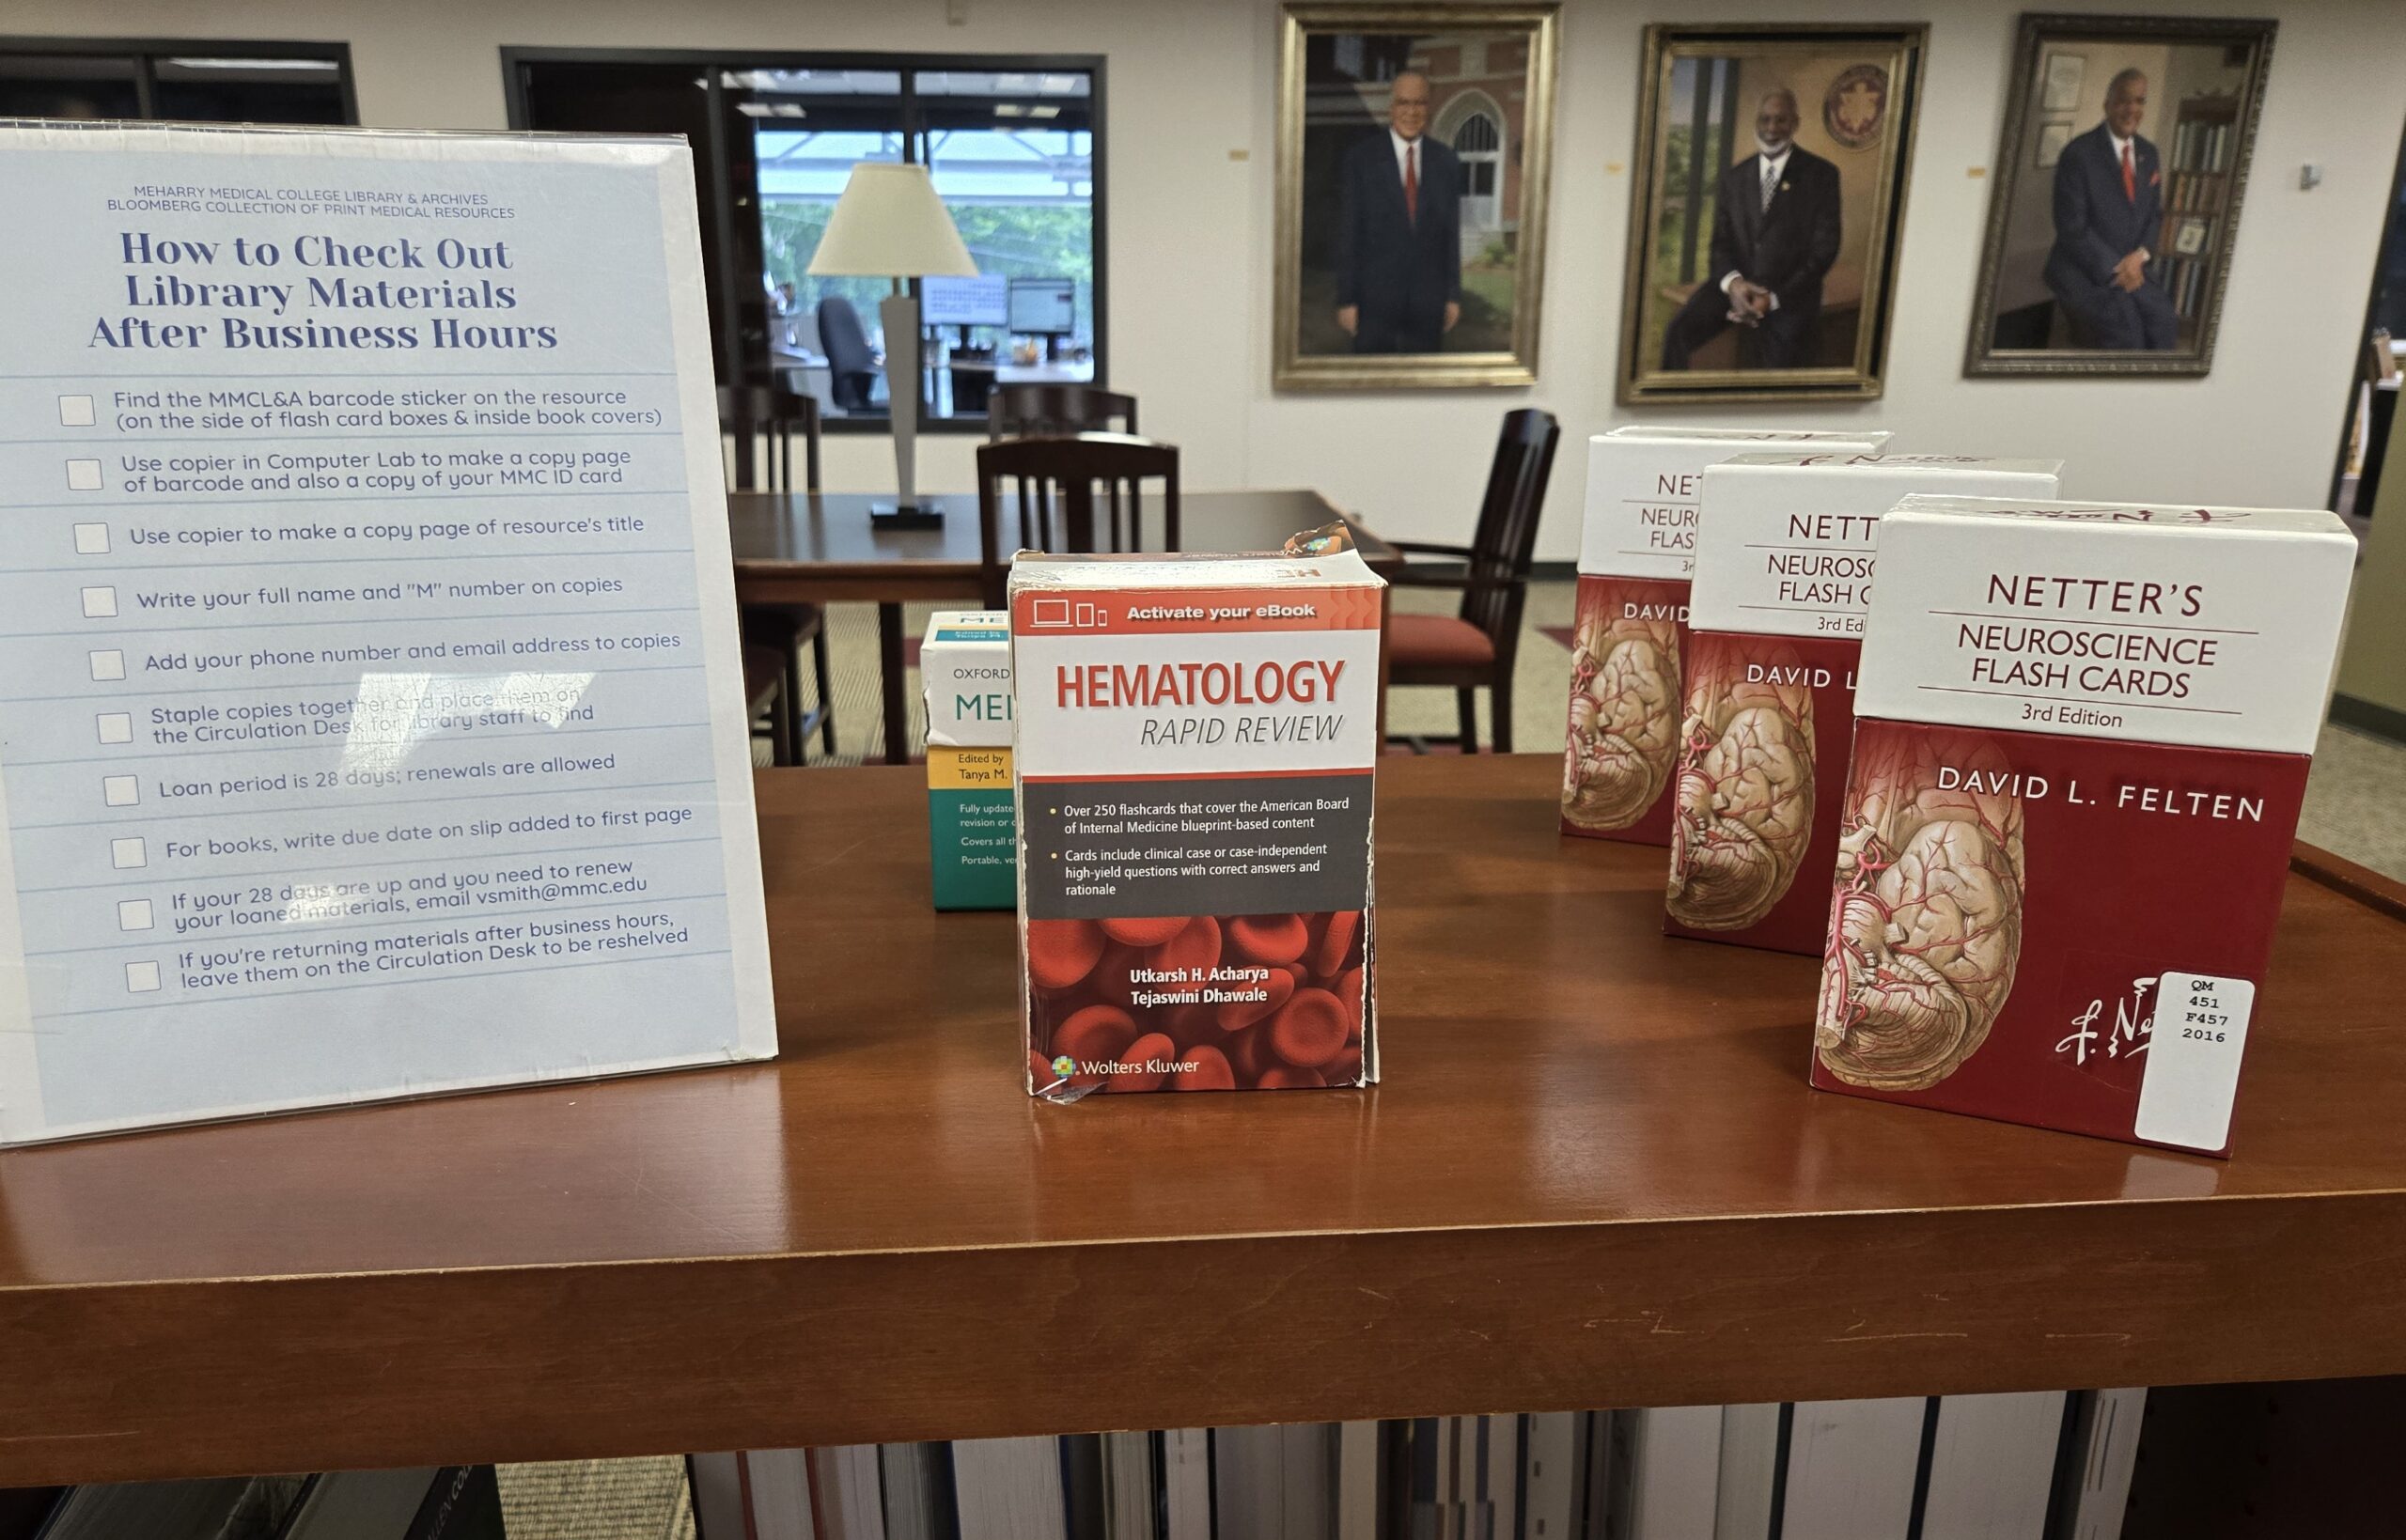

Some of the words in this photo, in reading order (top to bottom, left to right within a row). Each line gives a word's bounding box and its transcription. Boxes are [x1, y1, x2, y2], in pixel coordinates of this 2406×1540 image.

[133, 184, 205, 198] MEHARRY
[209, 186, 273, 200] MEDICAL
[275, 187, 340, 202] COLLEGE
[343, 189, 402, 204] LIBRARY
[407, 191, 417, 204] &
[420, 192, 488, 206] ARCHIVES
[106, 197, 201, 212] BLOOMBERG
[205, 200, 296, 215] COLLECTION
[300, 202, 319, 215] OF
[323, 203, 365, 216] PRINT
[370, 204, 430, 218] MEDICAL
[433, 205, 515, 220] RESOURCES
[122, 231, 220, 266] How
[232, 234, 279, 267] to
[293, 233, 424, 269] Check
[436, 234, 513, 270] Out
[127, 273, 293, 317] Library
[308, 274, 516, 309] Materials
[87, 314, 208, 349] After
[224, 315, 418, 350] Business
[433, 315, 557, 350] Hours
[114, 389, 160, 409] Find
[165, 389, 202, 408] the
[208, 388, 303, 408] MMCL&A
[308, 387, 395, 407] barcode
[400, 387, 467, 406] sticker
[473, 391, 498, 406] on
[503, 386, 536, 406] the
[541, 391, 626, 405] resource
[116, 410, 152, 433] (on
[158, 410, 195, 429] the
[201, 410, 243, 429] side
[250, 409, 273, 428] of
[277, 409, 329, 428] flash
[336, 408, 383, 428] card
[388, 408, 448, 428] boxes
[453, 407, 469, 427] &
[474, 406, 530, 426] inside
[536, 405, 586, 426] book
[590, 403, 662, 428] covers)
[1641, 507, 1698, 526] NEUR
[136, 588, 195, 609] Write
[202, 591, 252, 612] your
[257, 584, 289, 605] full
[296, 587, 355, 603] name
[362, 581, 400, 601] and
[448, 577, 525, 599] number
[531, 581, 555, 595] on
[561, 574, 623, 599] copies
[1779, 581, 1852, 605] FLASH
[1987, 574, 2203, 617] NETTER'S
[1126, 604, 1204, 620] Activate
[1208, 606, 1251, 622] your
[1255, 601, 1315, 617] eBook
[1624, 602, 1690, 623] DAVID
[1817, 616, 1841, 631] 3rd
[1958, 623, 2218, 666] NEUROSCIENCE
[953, 668, 1011, 679] OXFORD
[1056, 660, 1346, 708] HEMATOLOGY
[1746, 663, 1831, 688] DAVID
[1972, 658, 2070, 690] FLASH
[2079, 665, 2191, 699] CARDS
[2021, 703, 2053, 722] 3rd
[2058, 707, 2122, 728] Edition
[1140, 718, 1225, 745] RAPID
[1234, 714, 1343, 743] REVIEW
[958, 754, 990, 763] Edited
[992, 754, 1004, 766] by
[958, 769, 991, 783] Tanya
[993, 769, 1008, 780] M.
[1936, 766, 2050, 800] DAVID
[2068, 780, 2096, 805] L.
[2117, 786, 2265, 823] FELTEN
[960, 803, 981, 815] Fully
[1063, 803, 1091, 817] Over
[1093, 802, 1117, 817] 250
[1118, 801, 1176, 817] flashcards
[1179, 801, 1203, 815] that
[1205, 802, 1237, 815] cover
[1239, 799, 1258, 814] the
[1258, 797, 1312, 813] American
[1316, 795, 1350, 811] Board
[960, 818, 995, 827] revision
[1064, 820, 1076, 835] of
[1079, 819, 1123, 834] Internal
[1126, 818, 1179, 833] Medicine
[1180, 816, 1269, 834] blueprint-based
[1271, 815, 1315, 830] content
[961, 836, 993, 847] Covers
[995, 836, 1007, 847] all
[1064, 847, 1098, 862] Cards
[1100, 846, 1141, 862] include
[1143, 845, 1182, 861] clinical
[1185, 848, 1211, 859] case
[1213, 848, 1226, 859] or
[1228, 842, 1327, 860] case-independent
[1065, 863, 1120, 882] high-yield
[1123, 863, 1178, 881] questions
[1180, 862, 1206, 877] with
[1209, 861, 1248, 876] correct
[1250, 863, 1296, 875] answers
[1298, 858, 1320, 873] and
[1065, 881, 1116, 896] rationale
[179, 950, 194, 970] If
[199, 945, 265, 972] you're
[272, 936, 367, 961] returning
[373, 926, 469, 951] materials
[475, 923, 523, 942] after
[529, 916, 611, 938] business
[616, 910, 674, 930] hours,
[181, 971, 238, 990] leave
[243, 964, 298, 984] them
[305, 962, 331, 978] on
[336, 955, 370, 975] the
[376, 945, 483, 971] Circulation
[489, 938, 537, 960] Desk
[541, 938, 562, 956] to
[568, 934, 591, 953] be
[597, 924, 688, 951] reshelved
[1130, 966, 1187, 983] Utkarsh
[1191, 966, 1206, 982] H.
[1207, 965, 1269, 985] Acharya
[2191, 980, 2215, 992] QM
[1131, 988, 1199, 1009] Tejaswini
[1203, 986, 1267, 1003] Dhawale
[2188, 996, 2220, 1009] 451
[2185, 1012, 2229, 1027] F457
[2181, 1028, 2226, 1043] 2016
[1081, 1058, 1142, 1075] Wolters
[1146, 1057, 1199, 1074] Kluwer
